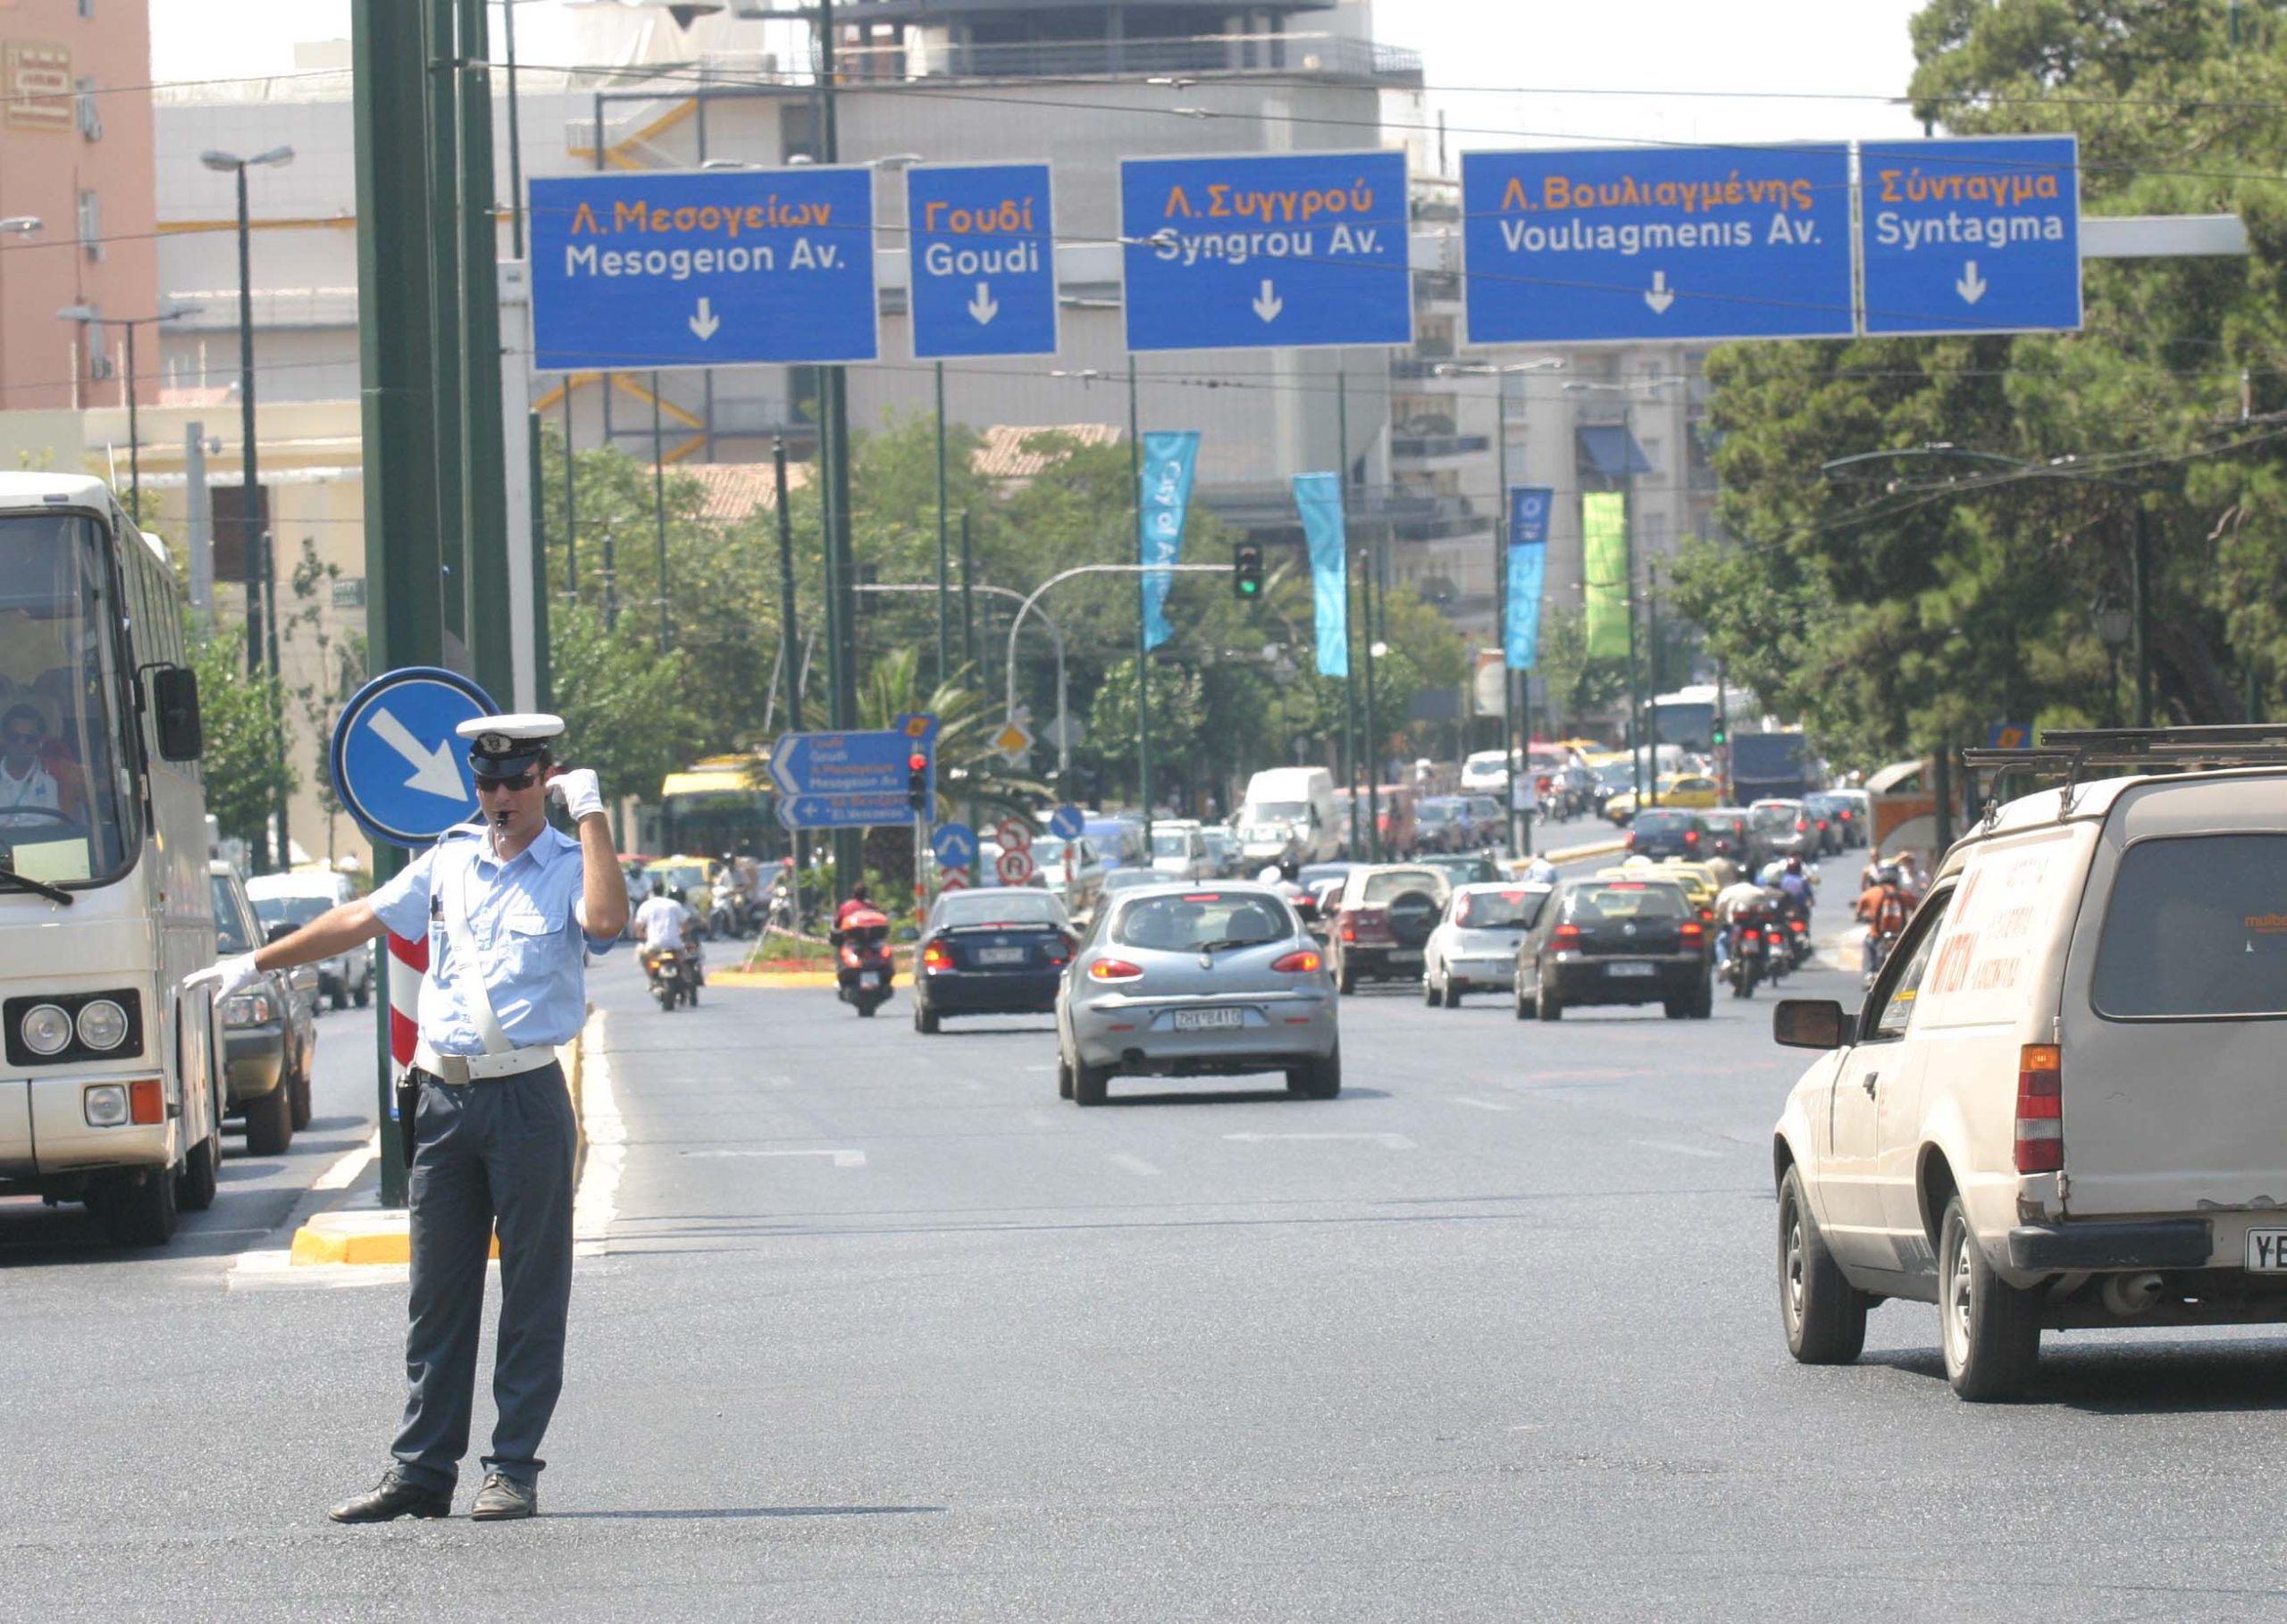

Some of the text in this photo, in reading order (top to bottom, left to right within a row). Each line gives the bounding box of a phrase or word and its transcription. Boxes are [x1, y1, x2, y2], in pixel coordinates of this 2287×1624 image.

[1880, 167, 2058, 206] Σύνταγμα
[926, 197, 1034, 234] Γουδί
[1500, 213, 1823, 255] Vouliagmenis Av.
[1876, 211, 2064, 249] Syntagma
[565, 238, 845, 280] Mesogeion Av.
[925, 242, 1039, 277] Goudi
[1154, 222, 1384, 266] Syngrou Av.
